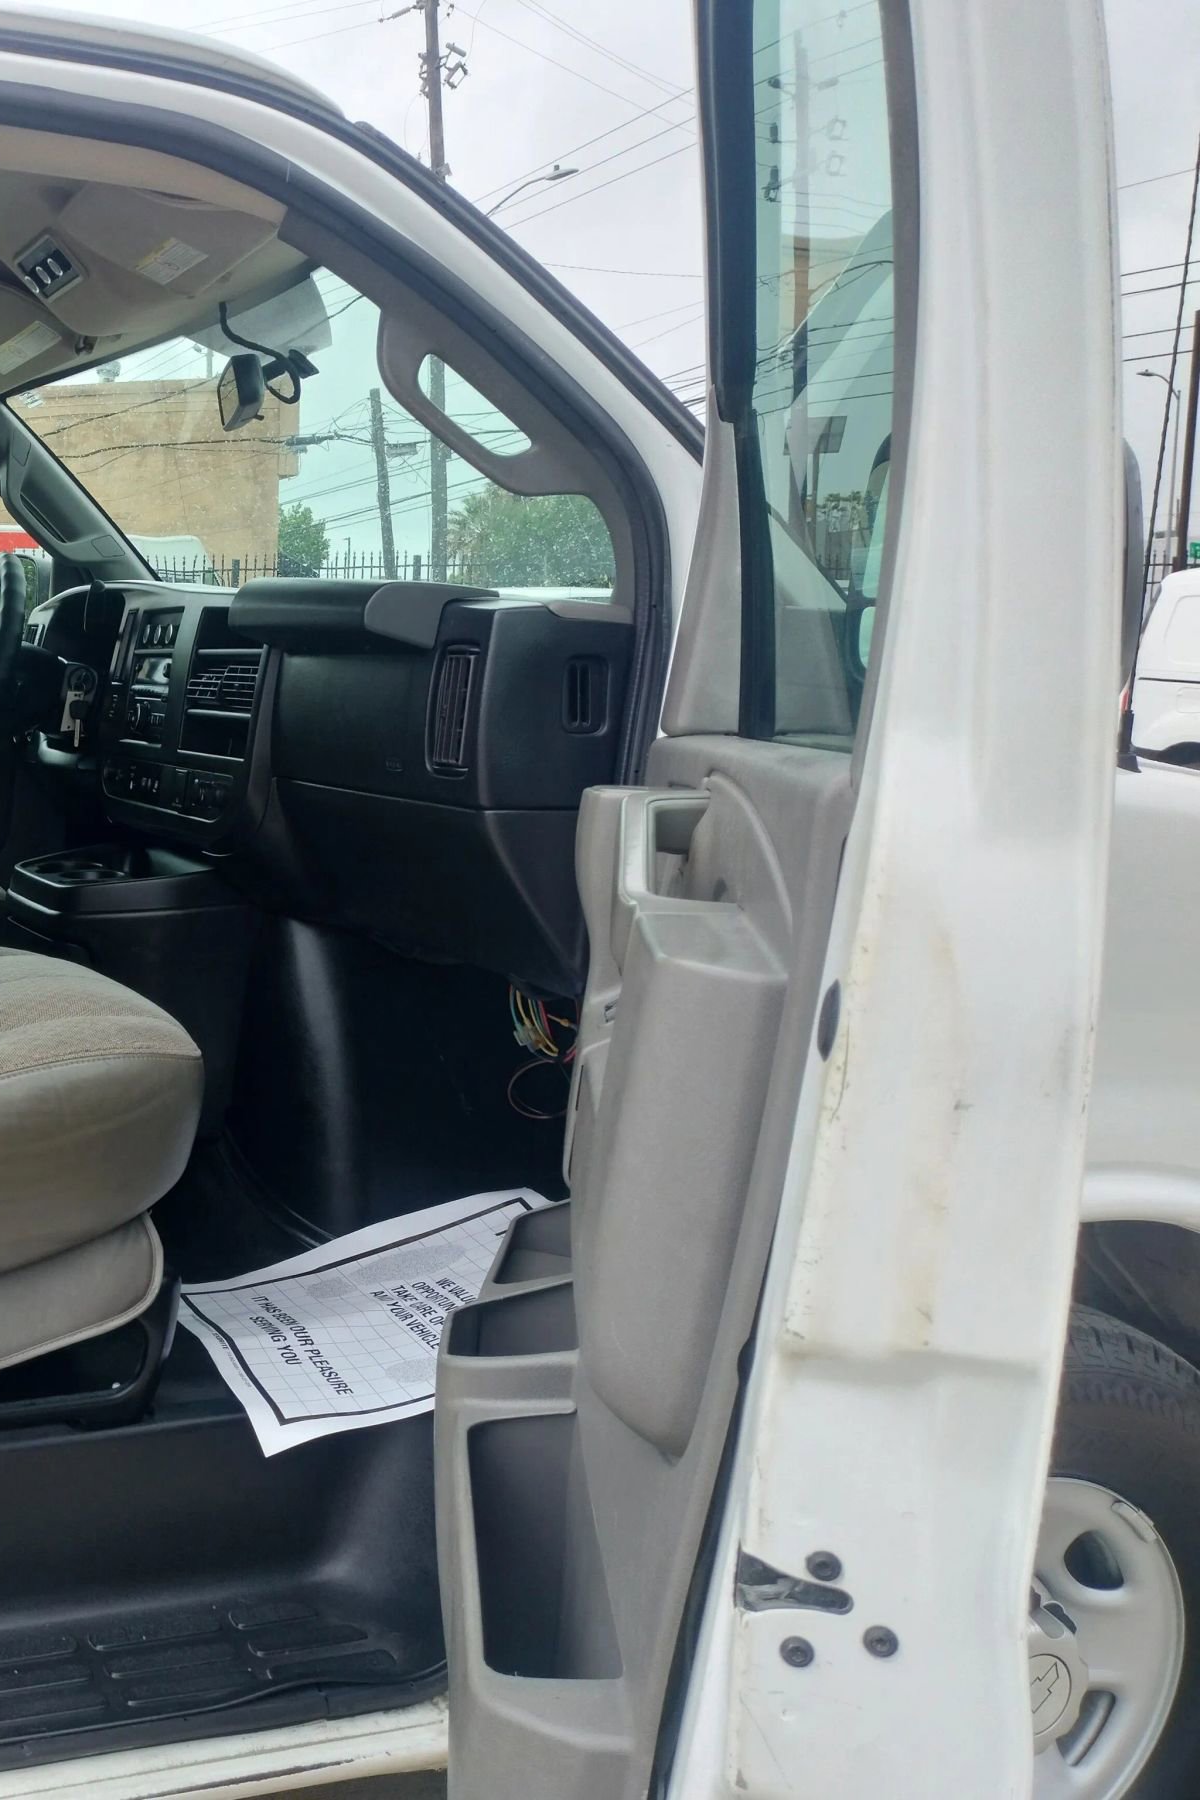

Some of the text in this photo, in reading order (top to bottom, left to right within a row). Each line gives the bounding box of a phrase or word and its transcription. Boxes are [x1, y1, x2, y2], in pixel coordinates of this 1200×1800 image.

[436, 1277, 456, 1290] WE
[387, 1301, 414, 1322] YOUR
[391, 1285, 419, 1302] TAKE
[409, 1301, 438, 1318] CARE
[249, 1315, 302, 1366] SERVING YOU
[251, 1295, 354, 1396] IT HAS BEEN OUR PLEASURE
